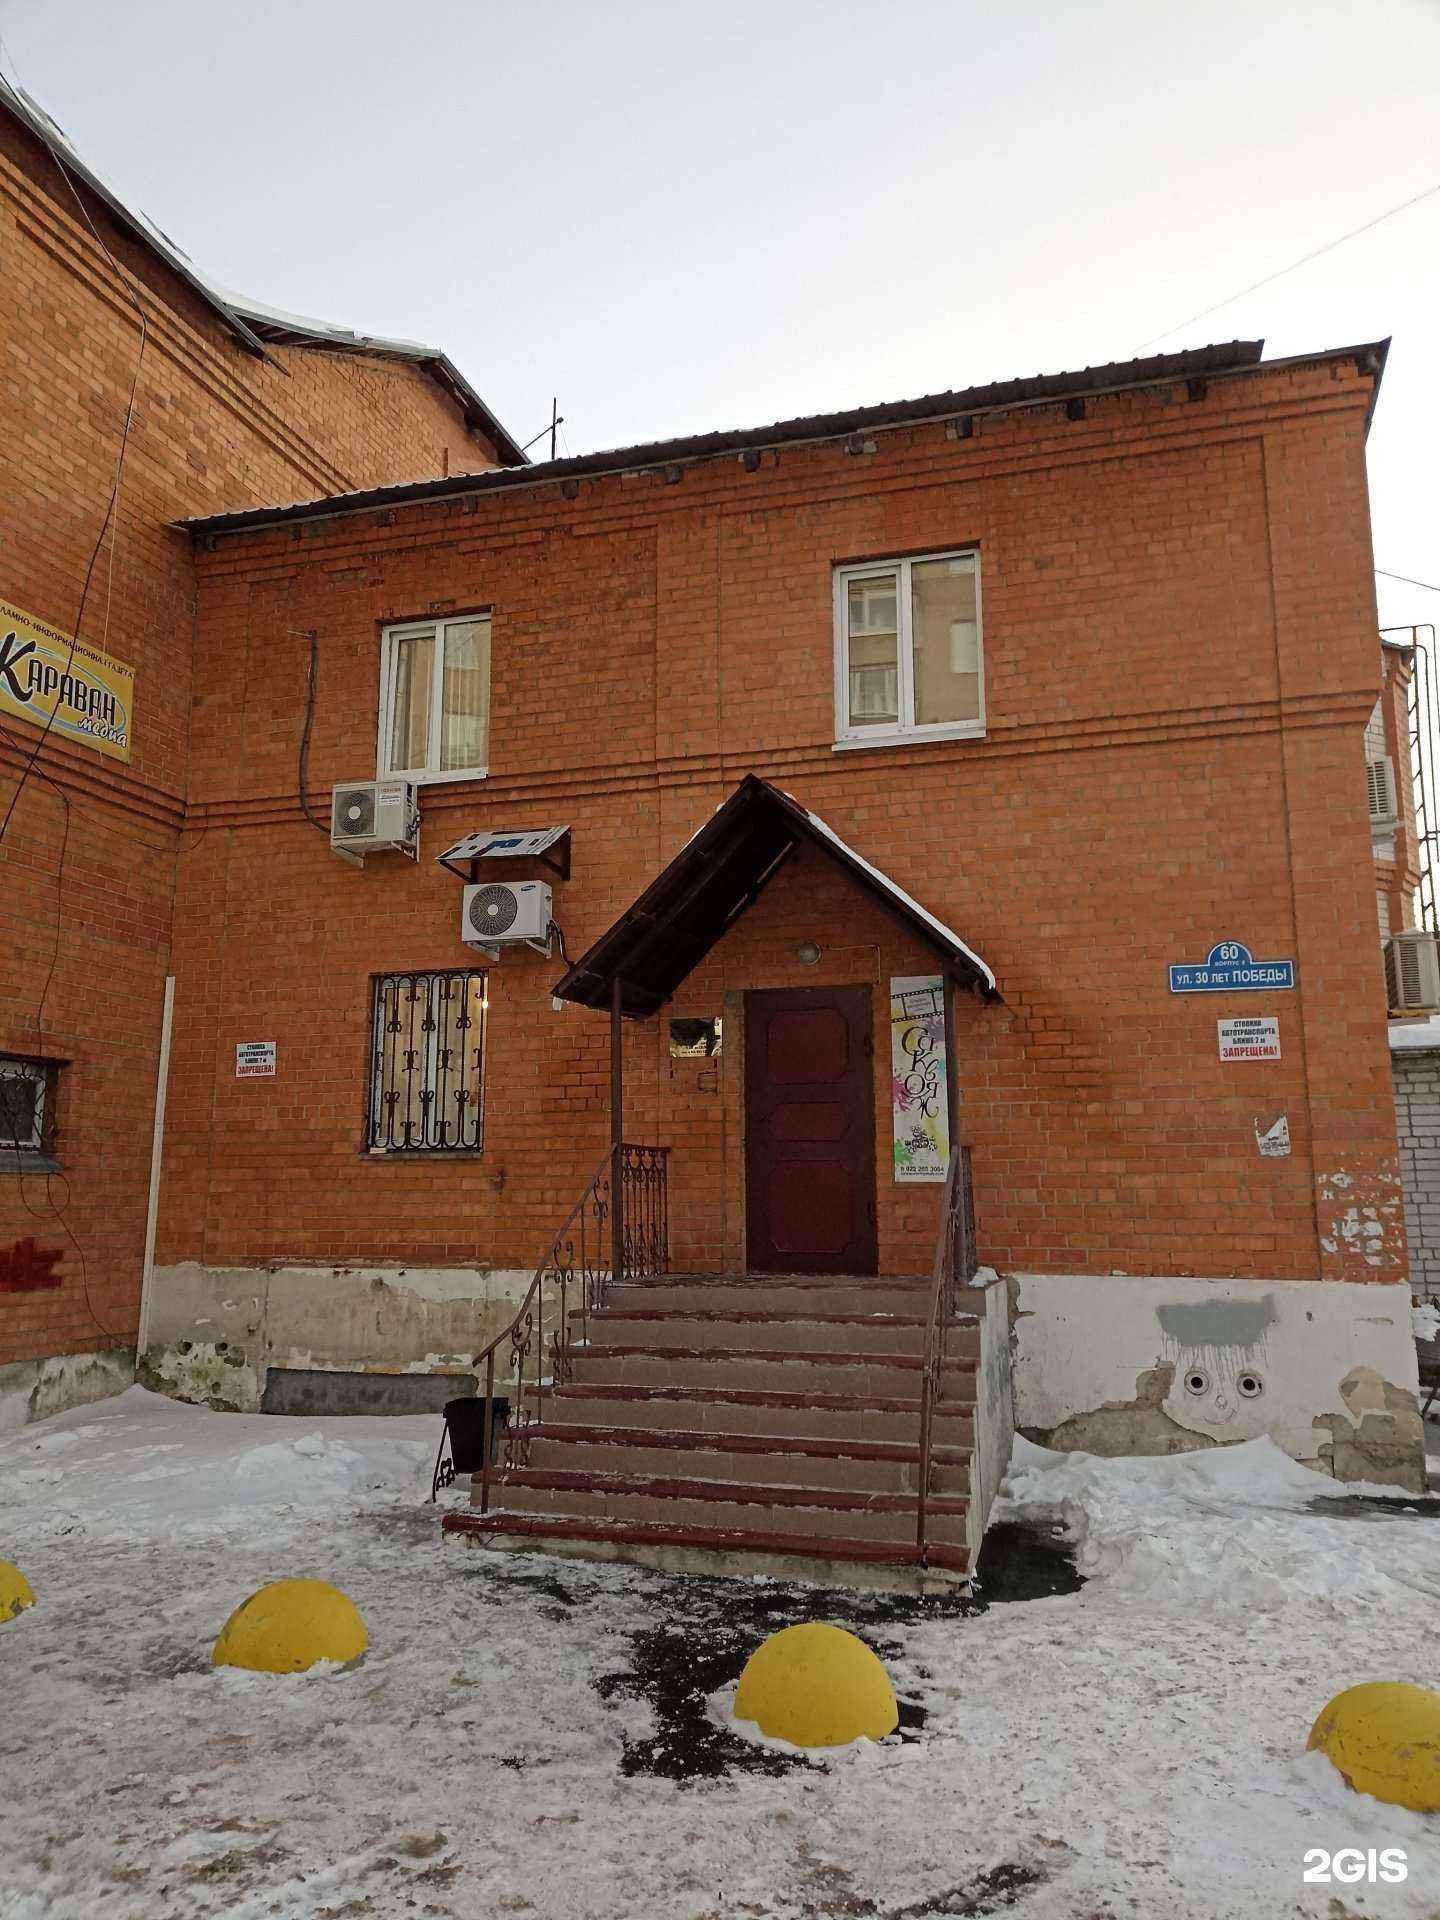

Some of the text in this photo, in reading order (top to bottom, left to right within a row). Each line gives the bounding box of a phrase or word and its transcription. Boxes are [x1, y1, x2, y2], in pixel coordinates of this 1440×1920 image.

[78, 716, 129, 748] медиа
[1220, 945, 1239, 960] 60
[1195, 971, 1209, 984] 30
[1232, 968, 1287, 984] ПОБЕДЫ
[1221, 1027, 1275, 1036] АВТОТРАНСПОРТА
[1222, 1045, 1278, 1058] ЗАПРЕЩЕНА!
